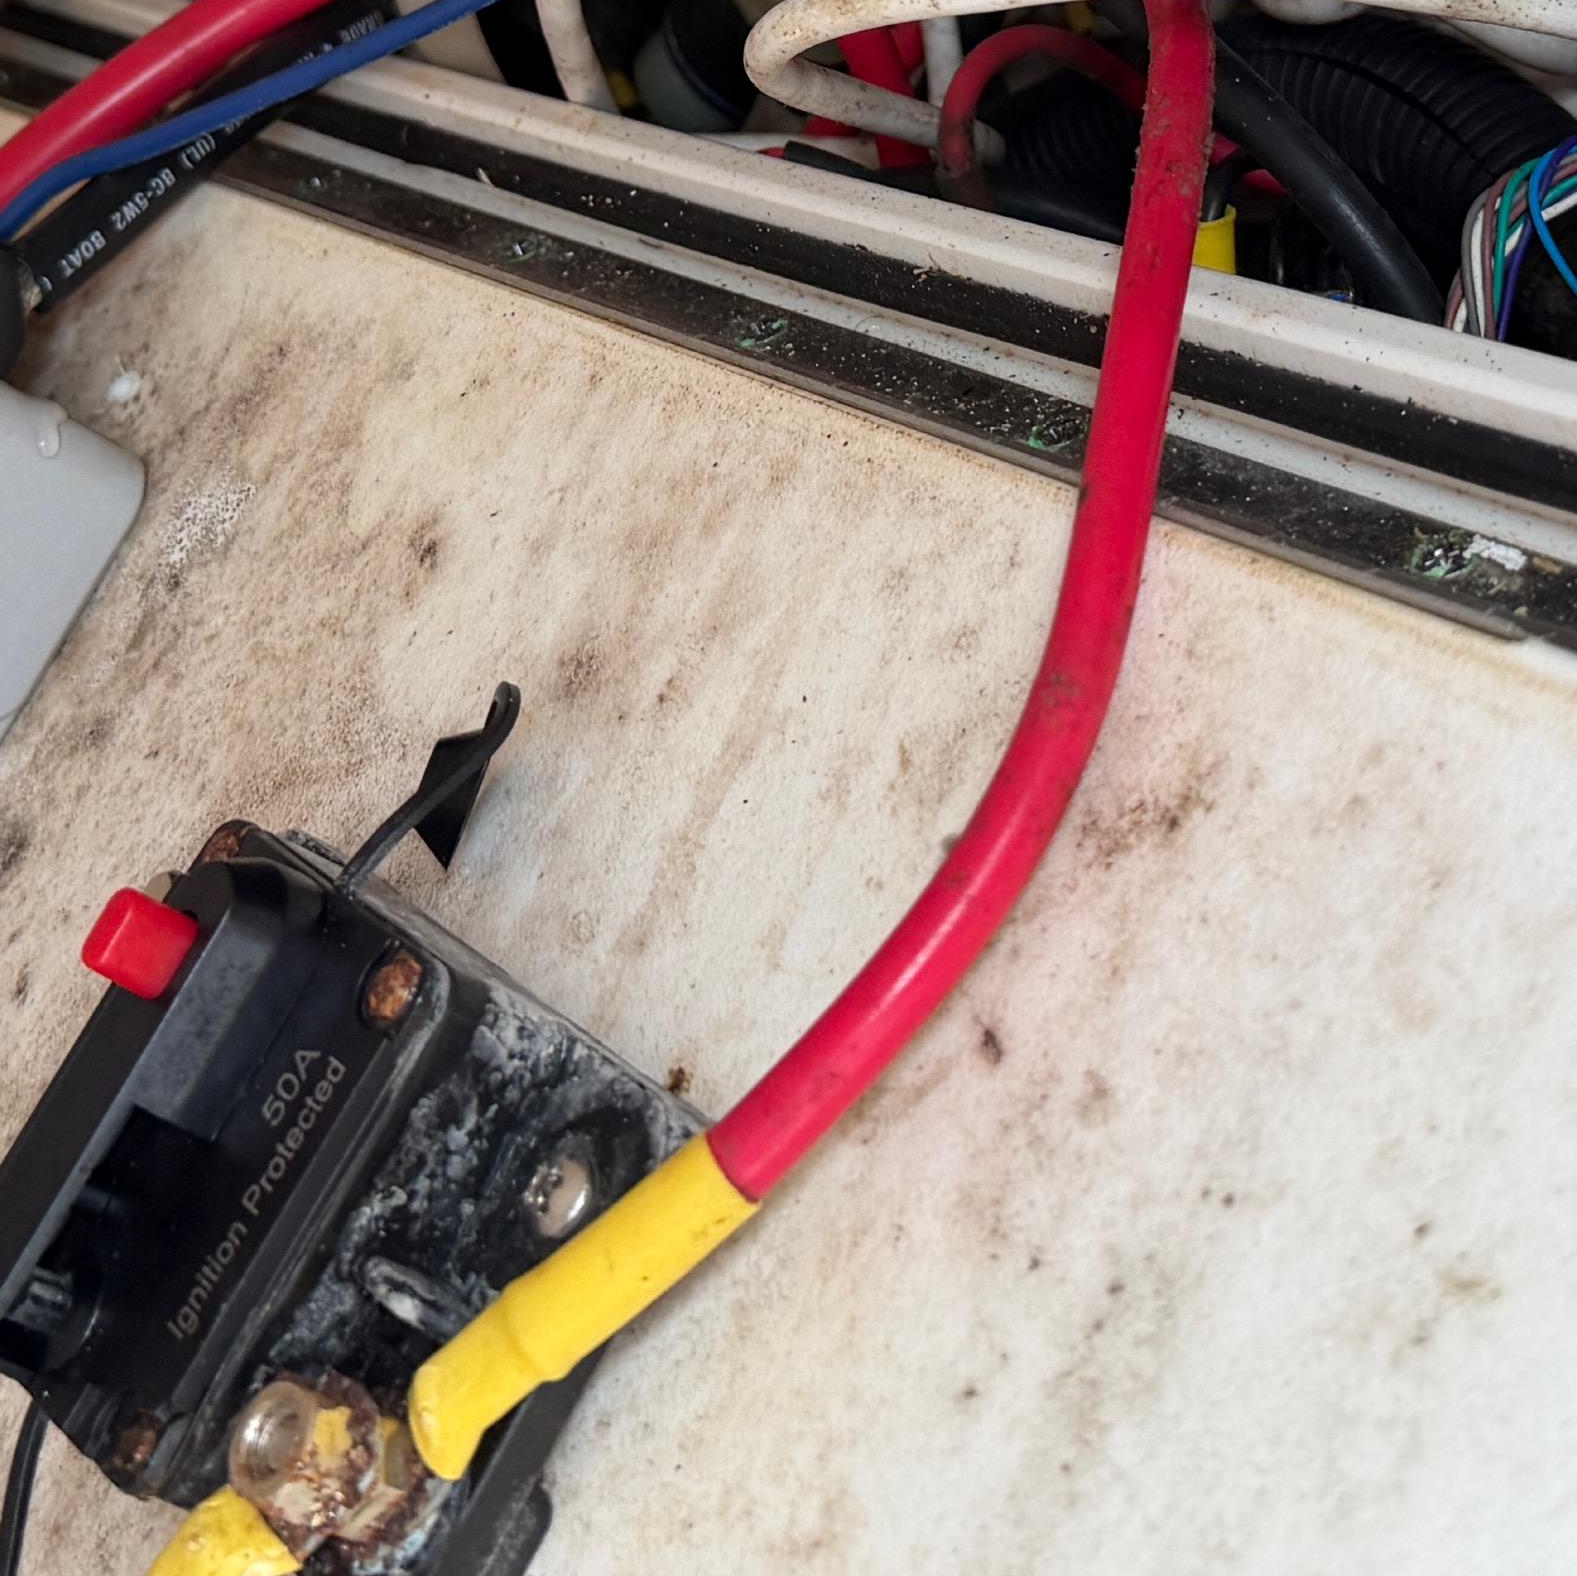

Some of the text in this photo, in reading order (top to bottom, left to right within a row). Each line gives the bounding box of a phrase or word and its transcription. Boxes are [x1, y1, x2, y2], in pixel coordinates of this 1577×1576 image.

[106, 167, 178, 230] BC-5W2
[55, 229, 108, 279] BOAT
[263, 1048, 321, 1127] 50A
[168, 1056, 346, 1341] Ignition Protected
